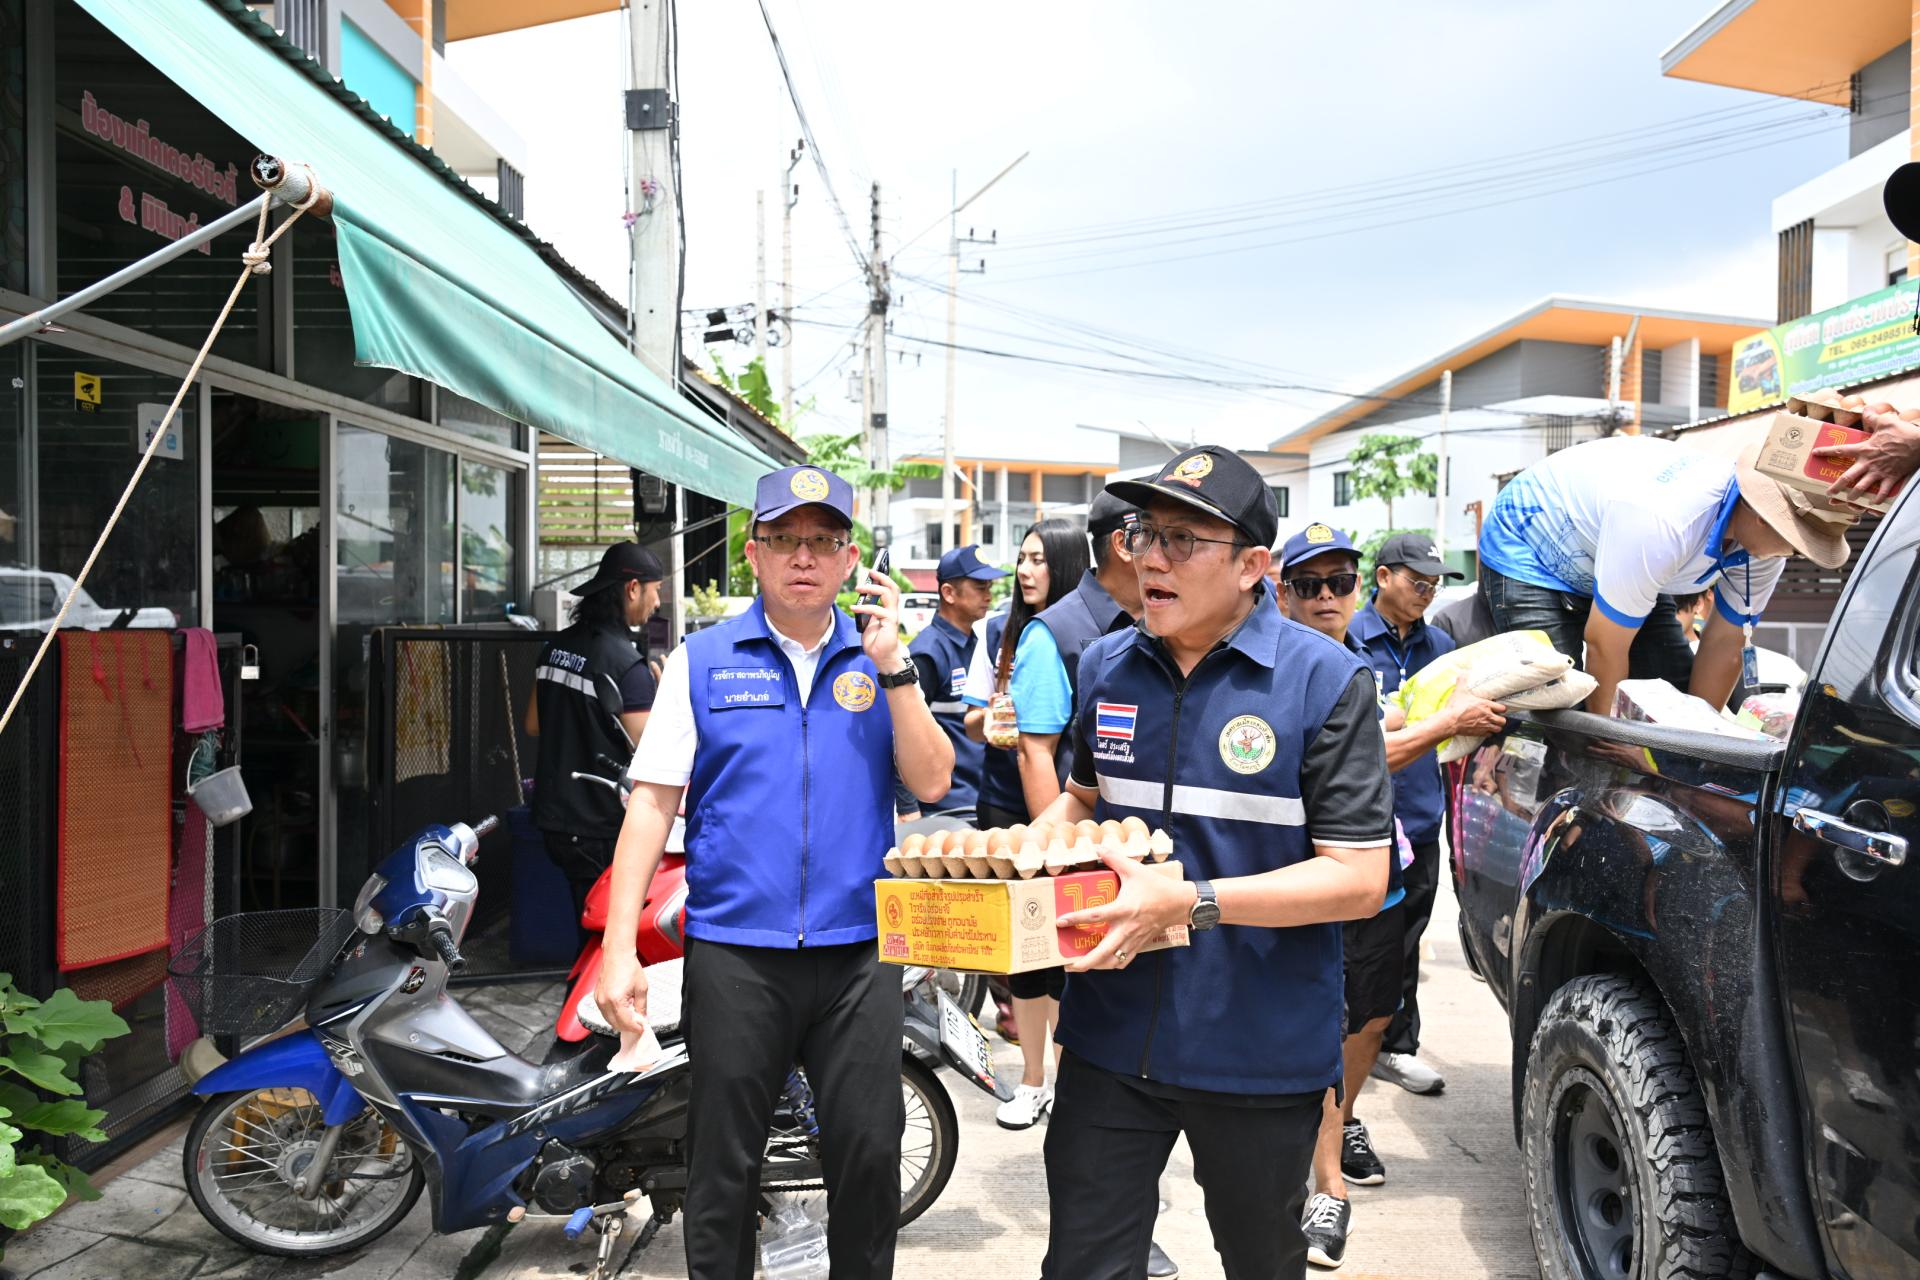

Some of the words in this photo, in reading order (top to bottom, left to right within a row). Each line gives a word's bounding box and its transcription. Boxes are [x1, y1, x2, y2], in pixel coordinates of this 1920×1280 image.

[118, 185, 137, 225] &
[141, 191, 211, 256] มินิมาร์
